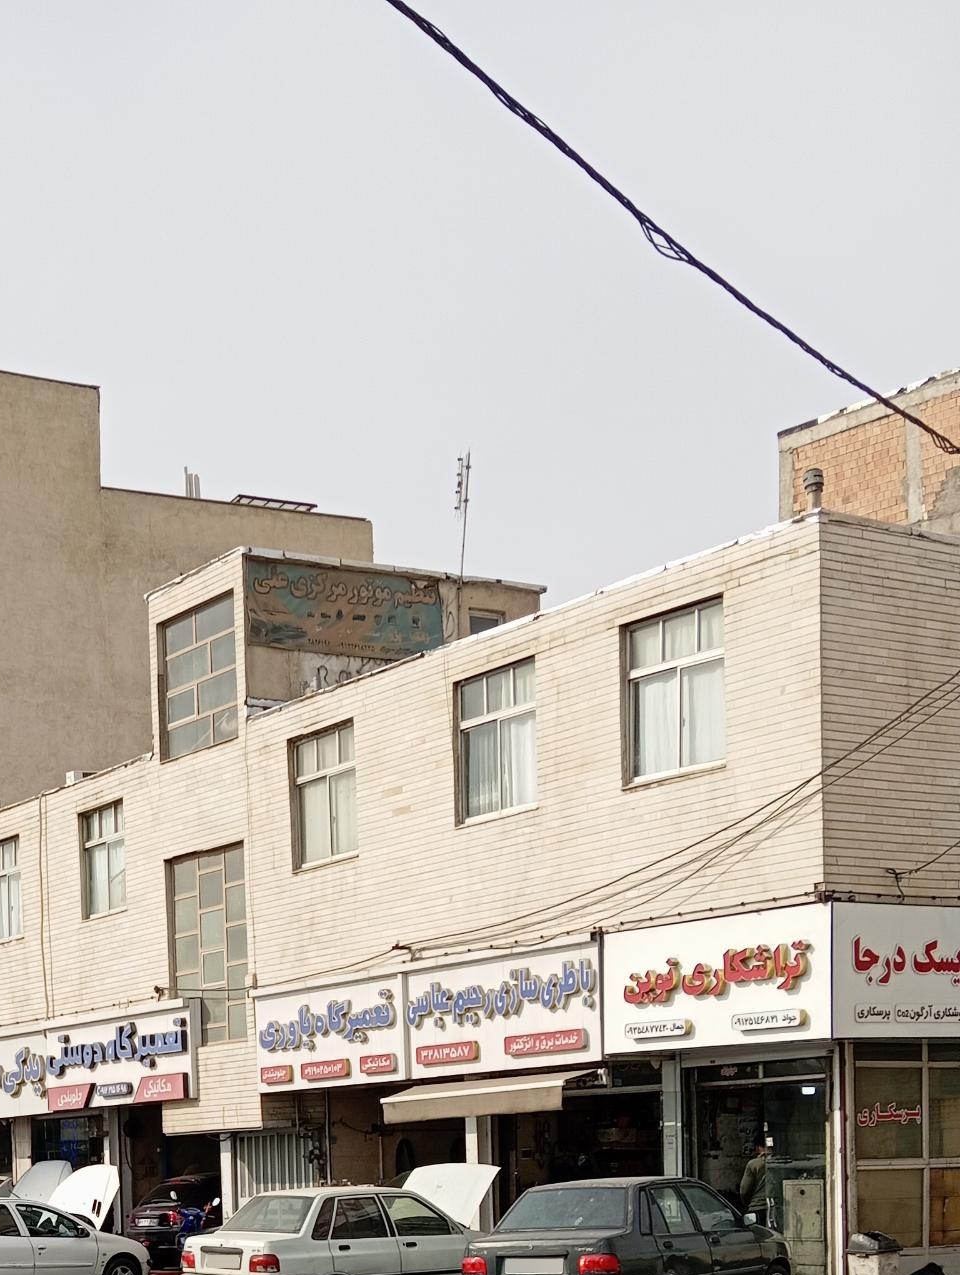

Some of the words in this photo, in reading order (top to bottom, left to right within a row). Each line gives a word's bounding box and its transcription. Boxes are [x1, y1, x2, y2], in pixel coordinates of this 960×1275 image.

[253, 565, 290, 595] علی
[290, 571, 348, 601] مرکزی
[348, 579, 391, 606] موتور
[682, 939, 812, 997] تراشکاری
[853, 936, 906, 985] درجا
[912, 939, 960, 986] یسک
[494, 968, 541, 1018] سازی
[540, 958, 597, 1013] باطری
[623, 957, 682, 1005] نوین
[315, 988, 394, 1044] تعمیرگاه
[406, 981, 453, 1031] عباسی
[452, 984, 495, 1026] رحیم
[857, 1006, 891, 1020] پرسکاری
[909, 1005, 933, 1021] آرگون
[934, 1007, 960, 1021] شکاری
[105, 1017, 188, 1069] تعمیرگاه
[259, 1004, 315, 1052] یاوری
[540, 1036, 554, 1050] برق
[555, 1032, 578, 1046] خدمات
[46, 1034, 106, 1078] دوستی
[420, 1045, 470, 1061] ۳۲۸۱۳۵۸۷
[509, 1036, 534, 1053] انژکتور
[361, 1056, 390, 1071] مکانیکی
[144, 1079, 171, 1098] مکانیکی
[857, 1102, 922, 1127] پرسکاری
